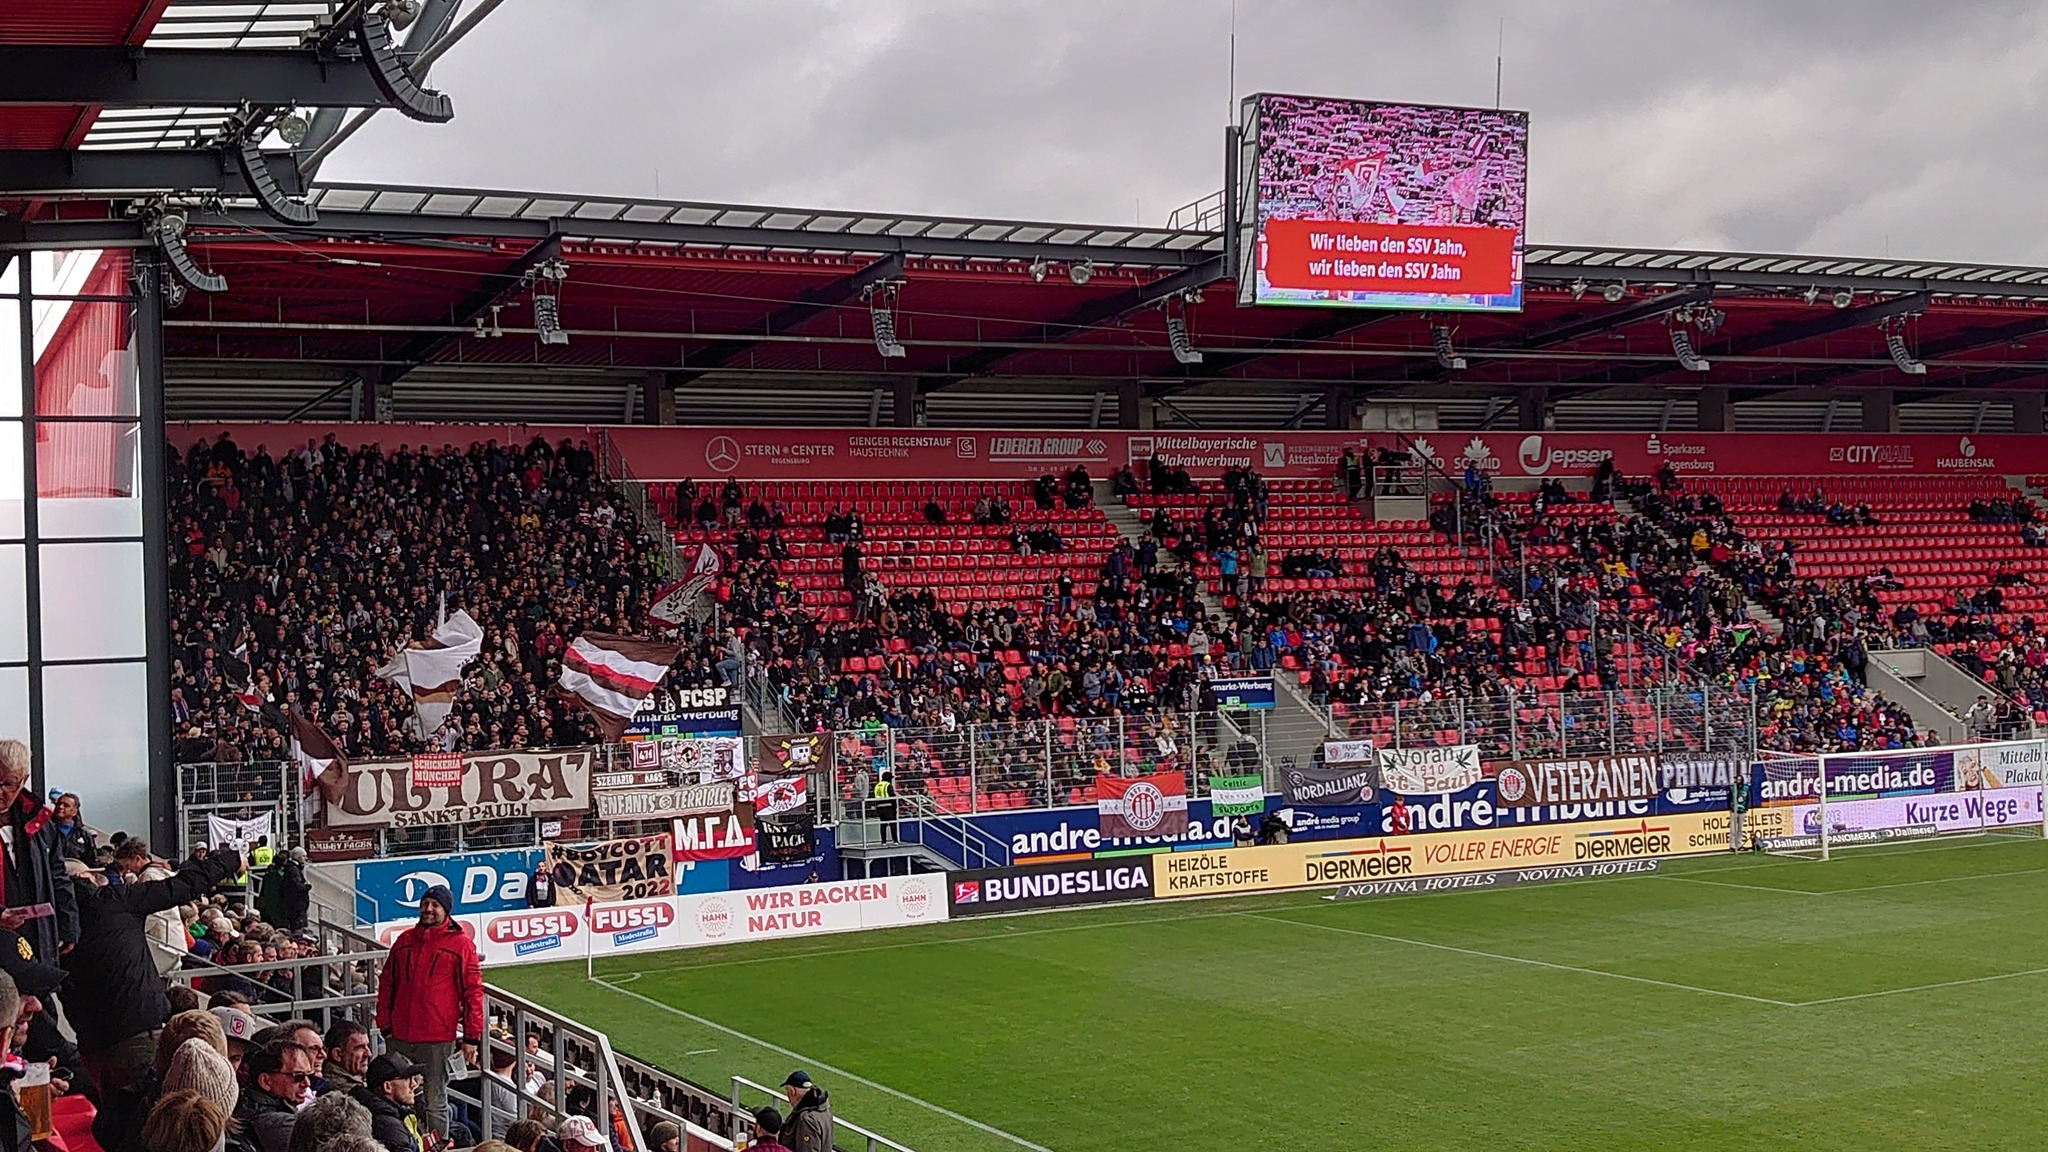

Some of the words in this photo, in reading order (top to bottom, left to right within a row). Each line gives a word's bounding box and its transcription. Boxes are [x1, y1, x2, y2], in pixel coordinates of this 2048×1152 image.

[1309, 232, 1334, 251] Wir
[1336, 233, 1378, 253] lieben
[1380, 238, 1405, 254] den
[1406, 238, 1431, 255] SSV
[1433, 240, 1467, 258] Jahn,
[1309, 259, 1333, 277] wir
[1333, 260, 1375, 277] lieben
[1378, 262, 1403, 278] den
[1404, 263, 1429, 279] SSV
[1430, 264, 1461, 280] Jahn
[745, 445, 780, 458] STERN
[791, 445, 835, 458] CENTER
[849, 436, 890, 448] GIENGER
[892, 436, 953, 448] REGENSTAUF
[989, 437, 1083, 455] LEDERER.GROUP
[1155, 436, 1258, 452] Mittelbayerische
[1662, 444, 1706, 456] Sparkasse
[849, 448, 910, 458] HAUSTECHNIK
[1157, 455, 1251, 470] Plakatwerbung
[1287, 453, 1339, 465] Attenkofer
[1937, 459, 1996, 468] HAUBENSAK
[679, 689, 727, 708] FCSP
[414, 759, 461, 770] SCHICKERIA
[1395, 747, 1454, 767] Voran
[414, 770, 461, 782] MÜNCHEN
[1411, 764, 1445, 776] 1910
[595, 773, 634, 787] SZENARIO
[1222, 780, 1247, 788] Celtic
[1292, 772, 1368, 802] NORDALLIANZ
[1386, 775, 1415, 791] St.
[1423, 768, 1479, 793] Pauli
[1525, 756, 1659, 804] VETERANEN
[601, 793, 656, 816] ENFANTS
[673, 786, 733, 810] TERRIBLES
[394, 807, 464, 828] SANKT
[468, 803, 528, 821] PAULI
[1905, 801, 1960, 826] Kurze
[1964, 797, 2018, 823] Wege
[1702, 812, 1783, 832] HOLZELLETS
[1827, 831, 1878, 843] PANOMERA
[1895, 826, 1936, 838] Dallmeier
[550, 835, 669, 862] #BOYCOTT
[1424, 841, 1486, 865] VOLLER
[1490, 835, 1562, 859] ENERGIE
[1774, 836, 1817, 849] Dallmeier
[1168, 854, 1228, 873] HEIZÖLE
[1516, 865, 1585, 883] NOVINA
[1589, 859, 1659, 877] HOTELS
[985, 866, 1149, 902] BUNDESLIGA
[1169, 869, 1269, 890] KRAFTSTOFFE
[1345, 881, 1418, 898] NOVINA
[1423, 873, 1497, 891] HOTELS
[622, 880, 670, 900] 2022
[746, 892, 793, 911] WIR
[799, 883, 887, 906] BACKEN
[902, 894, 927, 904] HAHN
[595, 904, 670, 929] FUSSL
[702, 912, 728, 923] HAHN
[748, 910, 822, 933] NATUR
[496, 915, 573, 940] FUSSL
[616, 928, 655, 943] Modestraße
[519, 938, 557, 953] Modestraße
